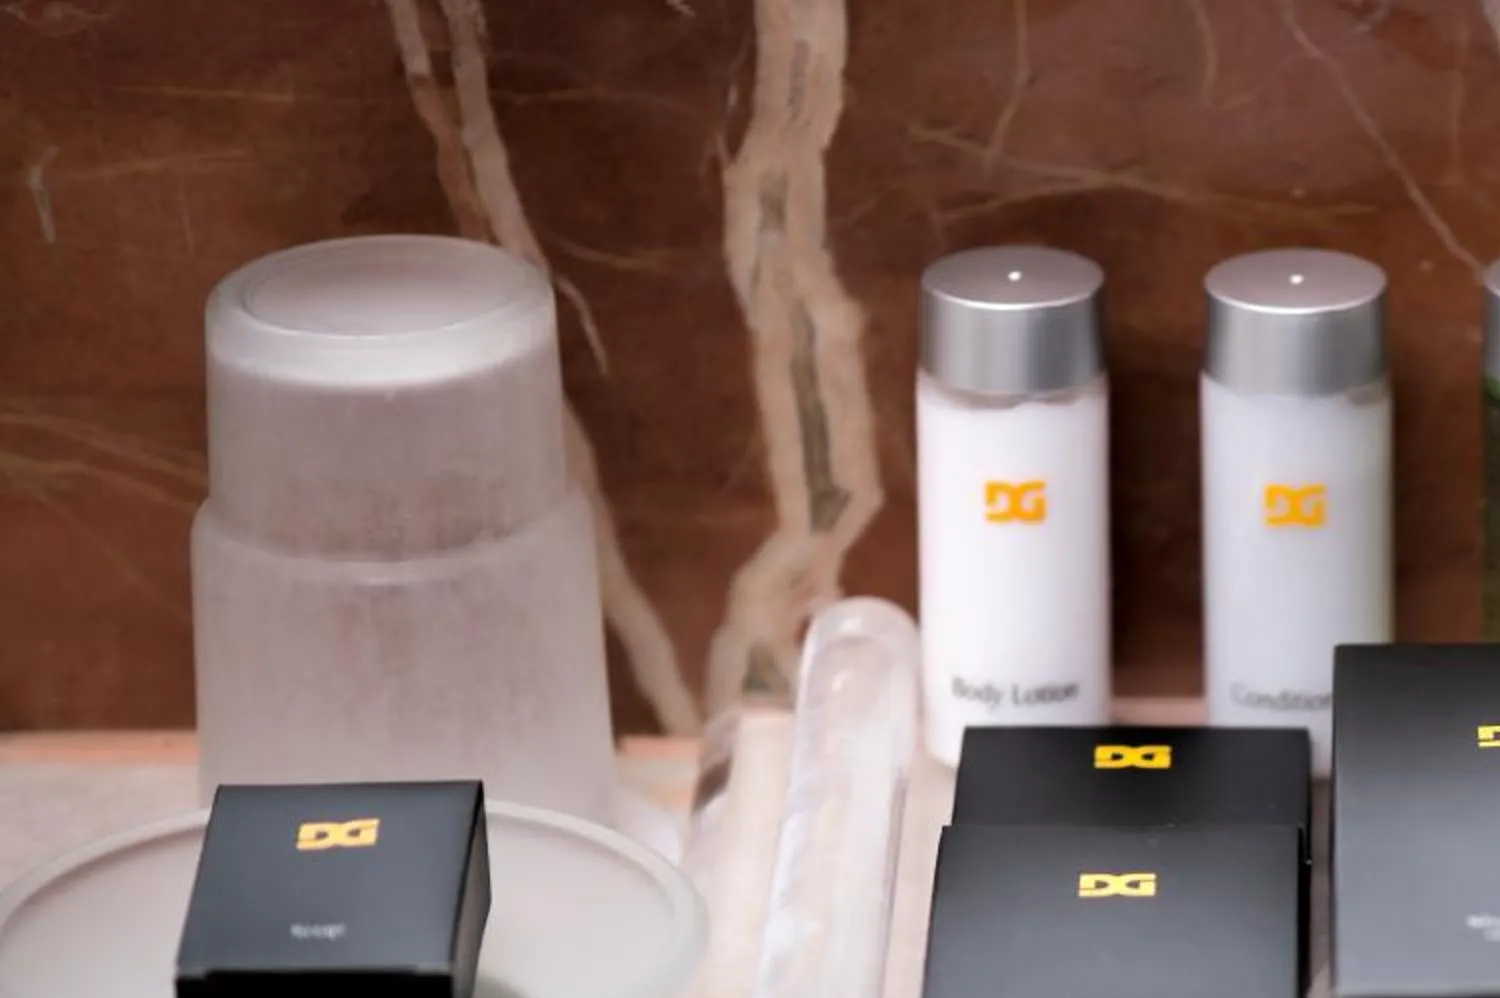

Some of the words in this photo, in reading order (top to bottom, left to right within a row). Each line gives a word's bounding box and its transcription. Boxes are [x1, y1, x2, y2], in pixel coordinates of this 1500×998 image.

[984, 480, 1047, 524] DG
[1262, 483, 1326, 527] DG
[1229, 681, 1334, 713] Condition
[1094, 745, 1171, 768] DG
[1078, 873, 1156, 897] DG
